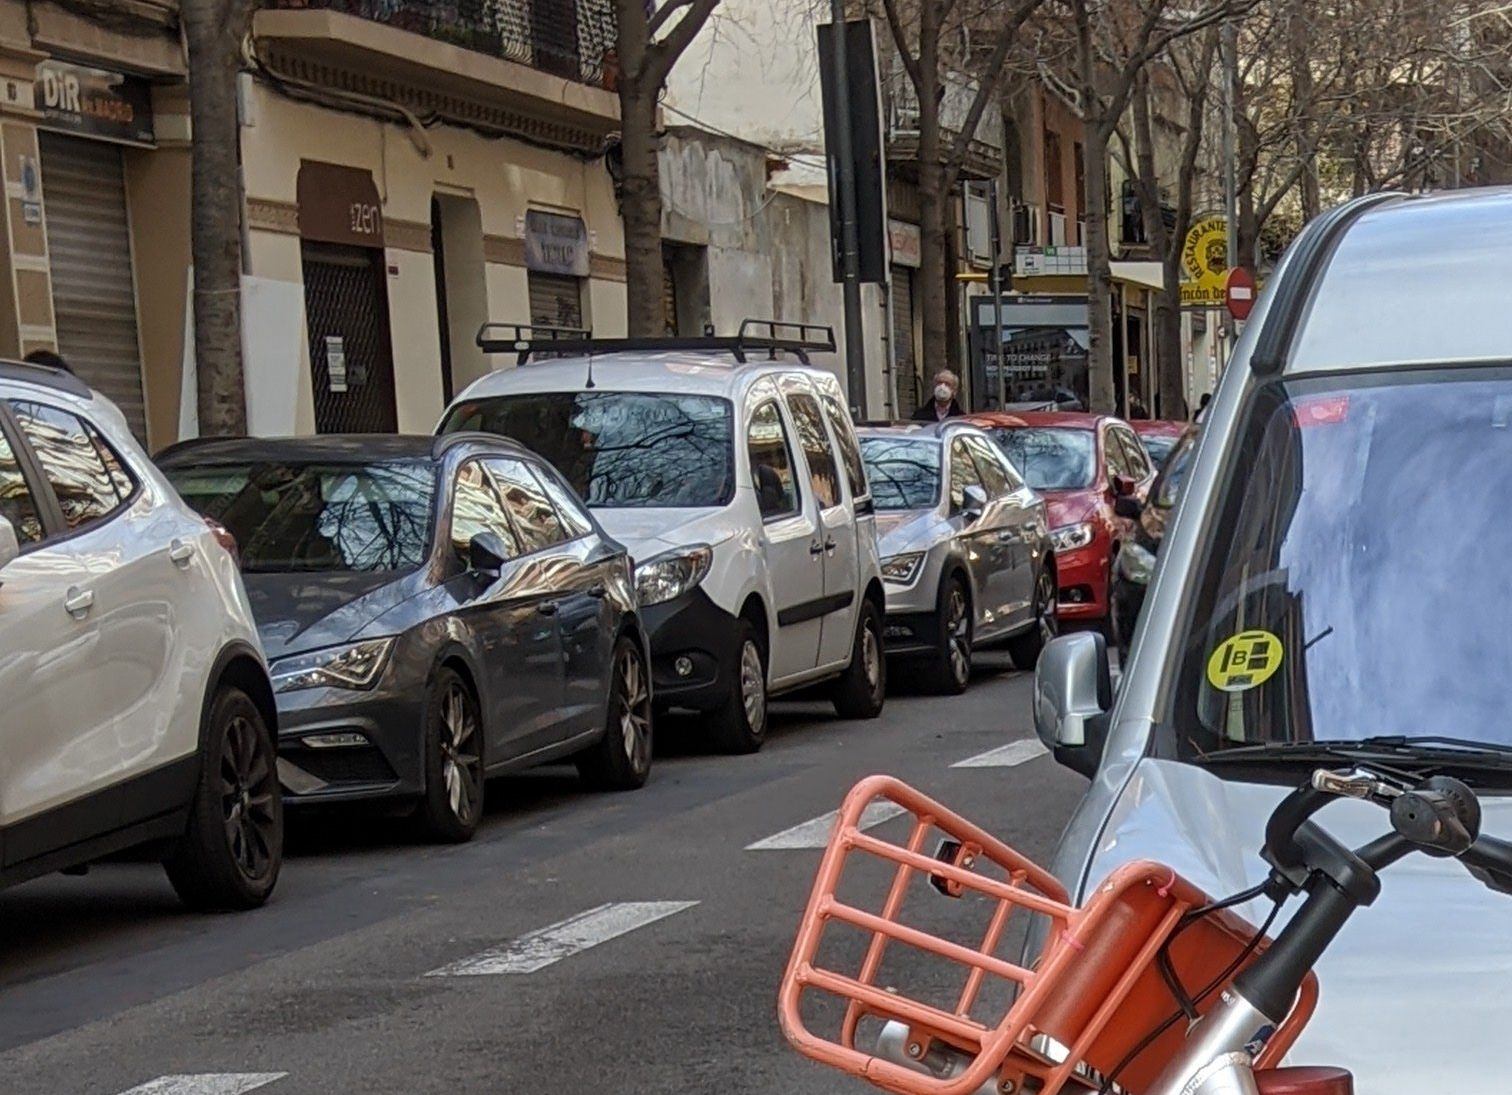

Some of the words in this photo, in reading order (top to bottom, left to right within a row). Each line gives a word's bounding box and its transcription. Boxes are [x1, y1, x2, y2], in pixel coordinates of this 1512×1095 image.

[355, 203, 380, 234] zen
[1185, 220, 1227, 279] RESTAURANTE
[1231, 650, 1248, 666] B
